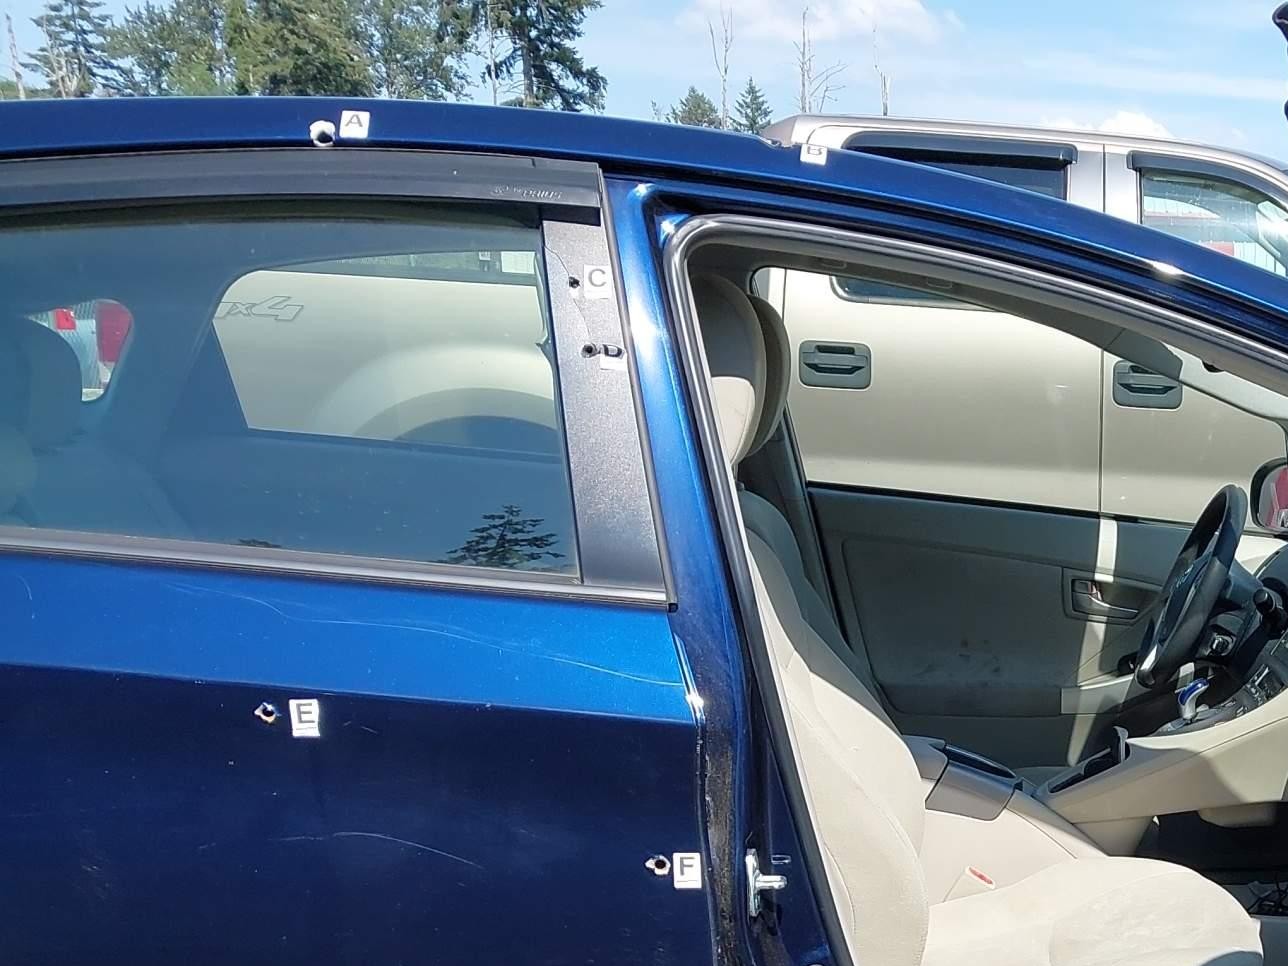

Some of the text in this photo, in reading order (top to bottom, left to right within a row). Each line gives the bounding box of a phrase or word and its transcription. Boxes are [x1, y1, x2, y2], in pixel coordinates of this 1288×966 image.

[345, 113, 363, 128] A
[588, 268, 607, 287] C
[602, 344, 623, 358] D
[296, 703, 315, 723] E
[680, 857, 695, 876] F
